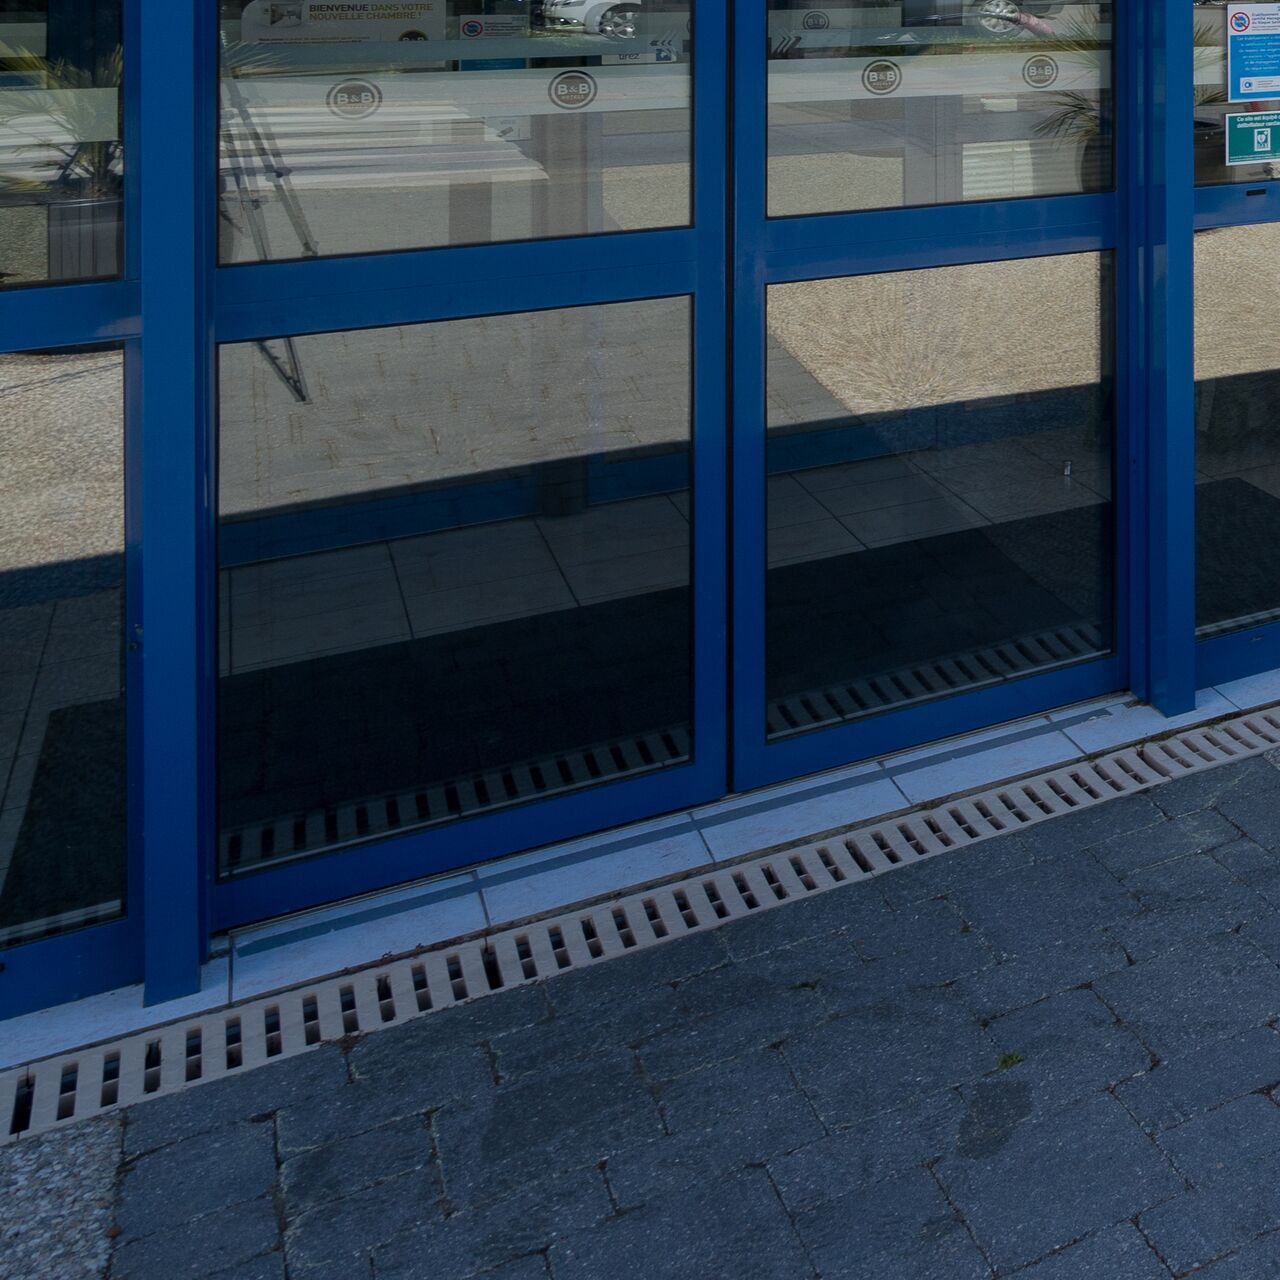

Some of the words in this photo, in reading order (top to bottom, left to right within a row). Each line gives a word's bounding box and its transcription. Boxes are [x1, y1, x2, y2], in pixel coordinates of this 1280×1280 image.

[308, 4, 369, 12] BIENVENUE
[371, 4, 399, 12] DANS
[401, 3, 433, 11] VOTRE
[309, 12, 364, 20] NOUVELLE
[366, 12, 417, 20] CHAMBRE
[557, 83, 590, 95] B&B
